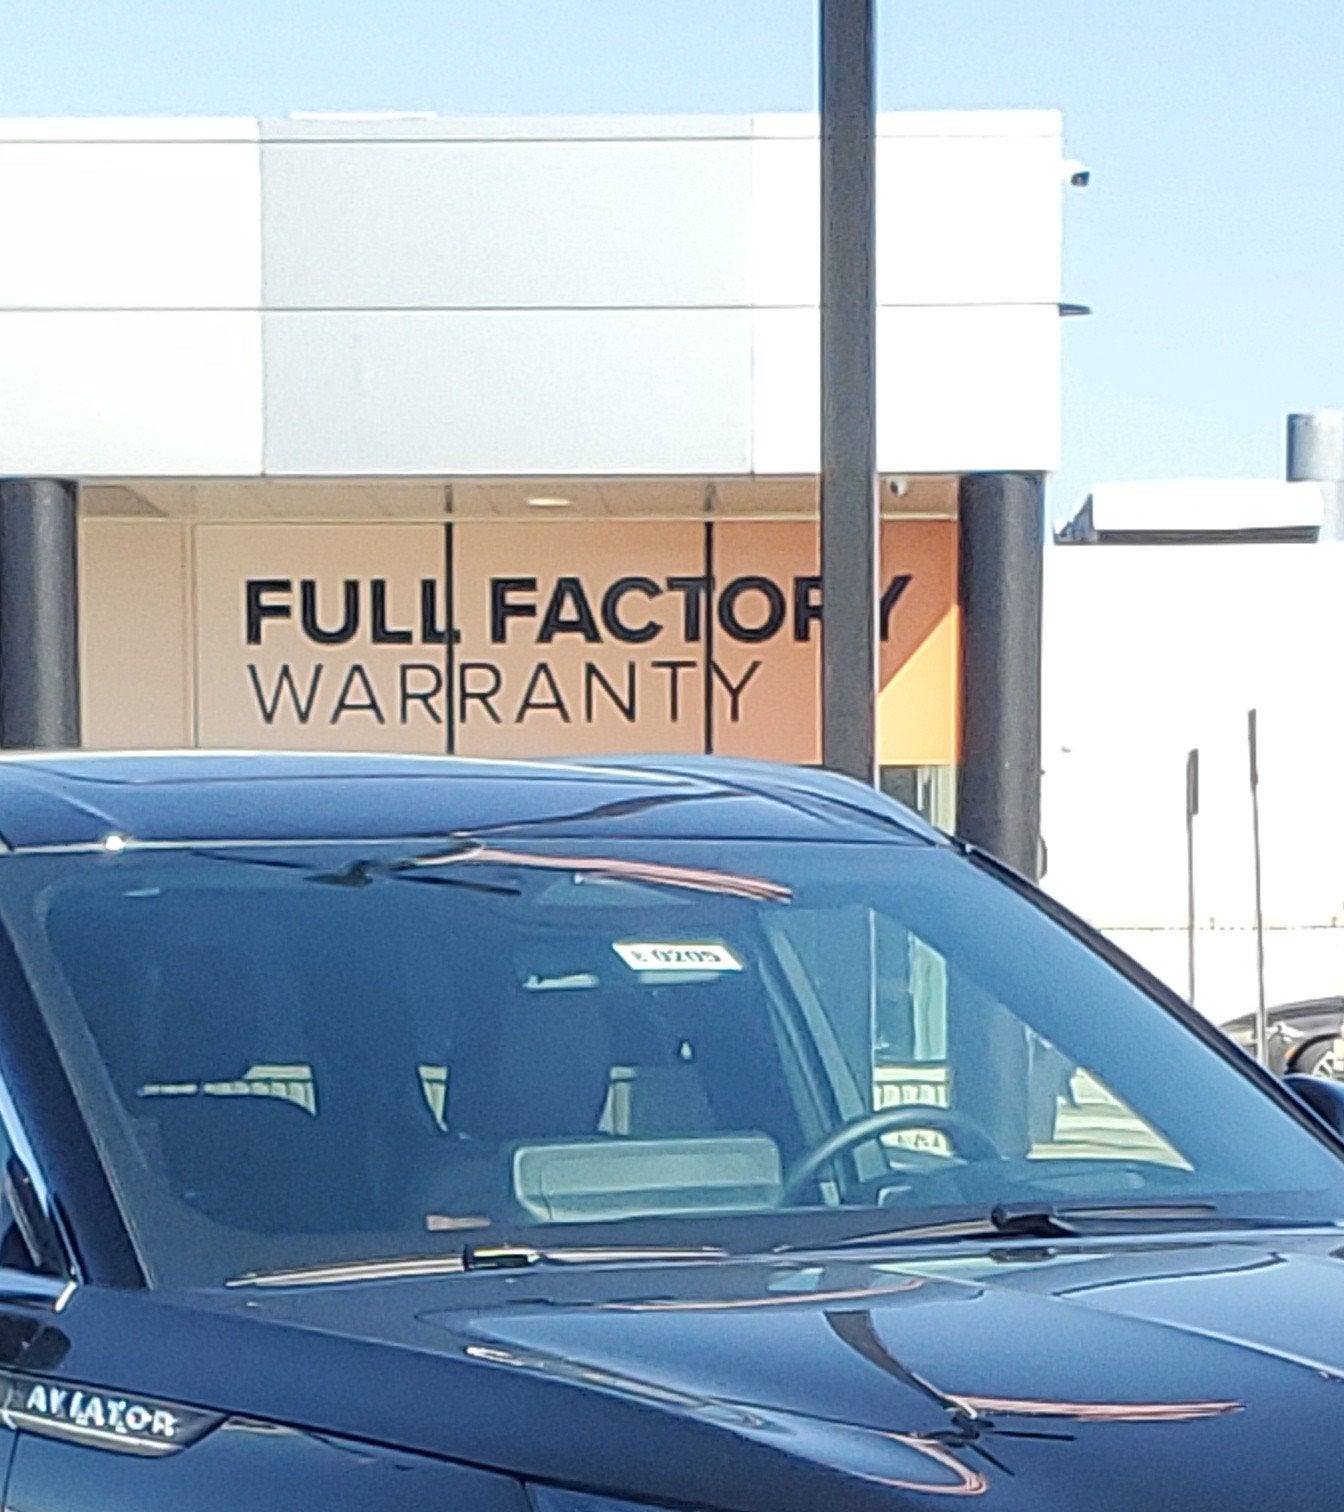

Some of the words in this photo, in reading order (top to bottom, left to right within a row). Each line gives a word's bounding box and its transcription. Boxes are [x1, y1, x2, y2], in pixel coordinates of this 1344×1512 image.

[245, 578, 461, 645] FULL
[247, 660, 762, 725] WARRANTY
[26, 1385, 175, 1437] AVIATOR
